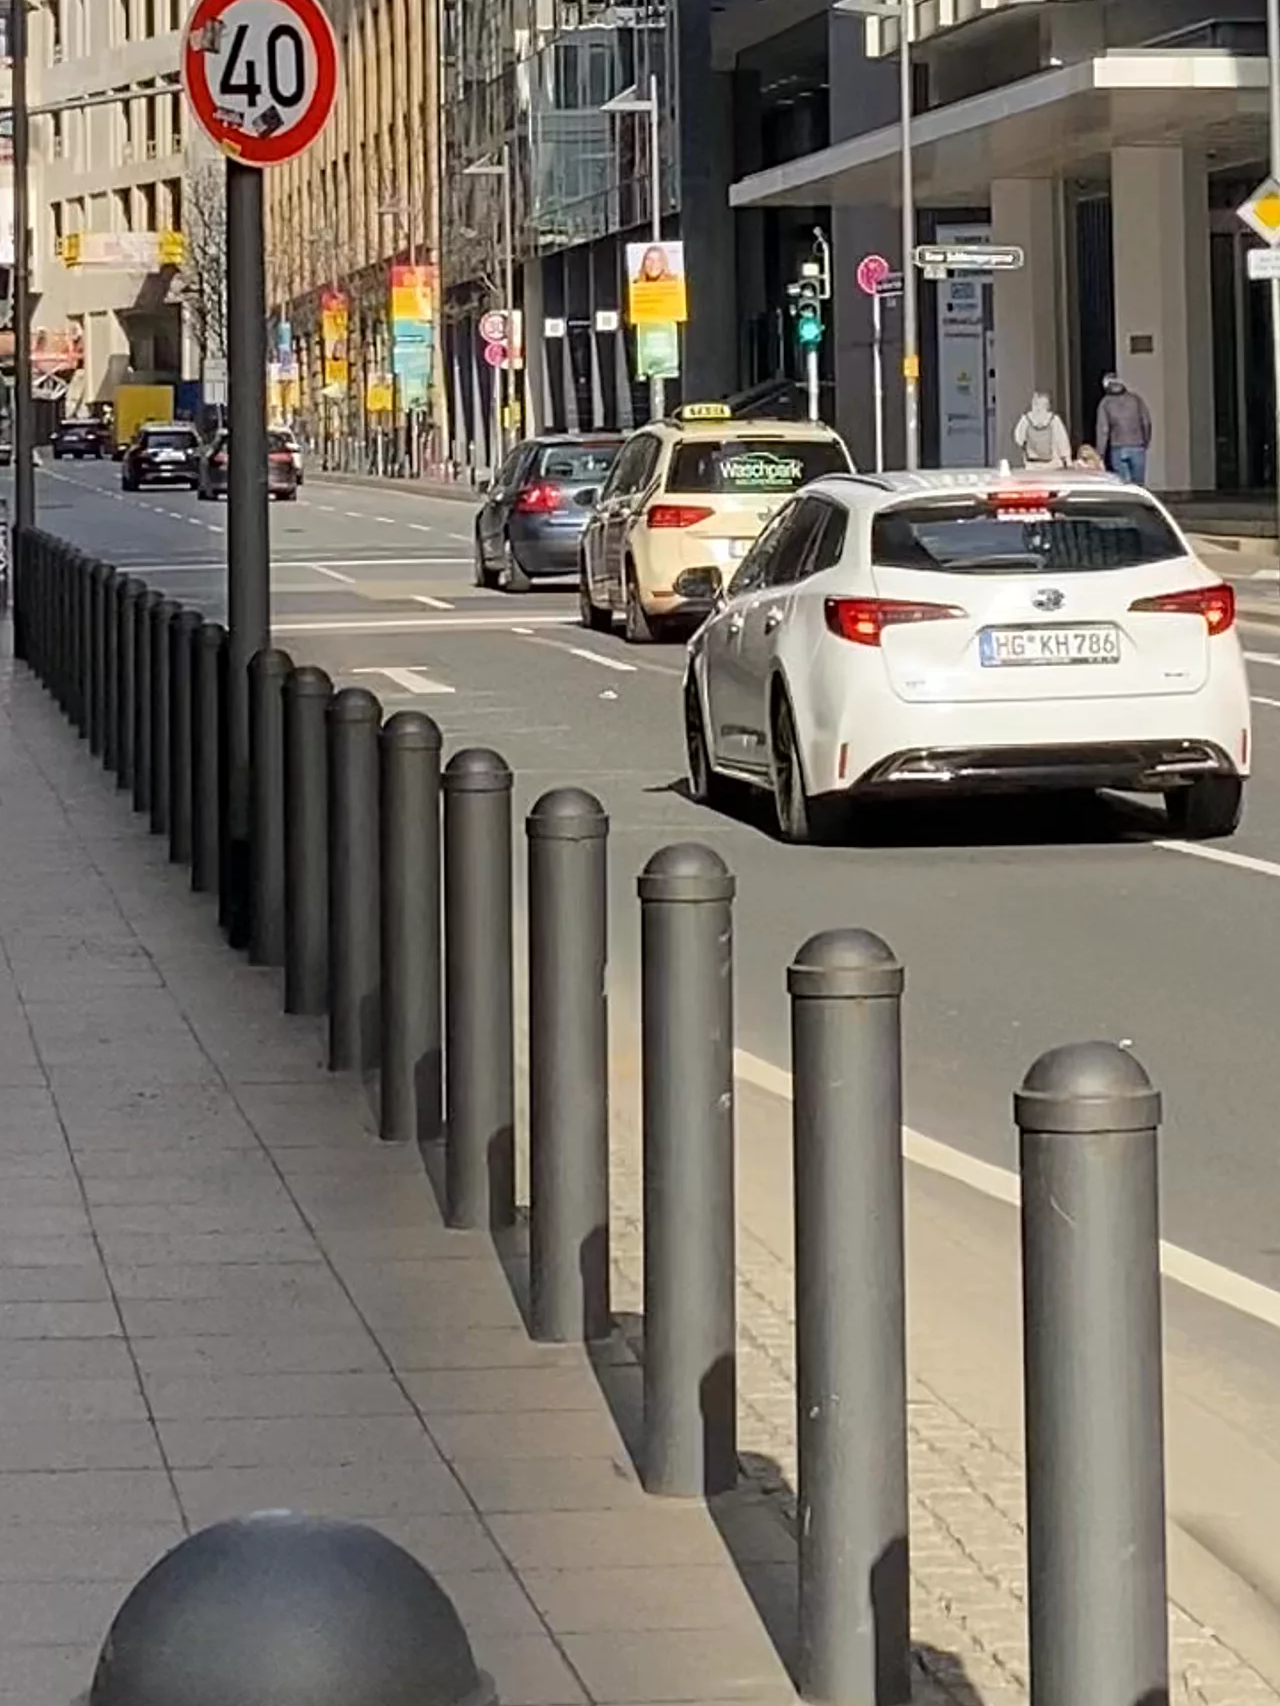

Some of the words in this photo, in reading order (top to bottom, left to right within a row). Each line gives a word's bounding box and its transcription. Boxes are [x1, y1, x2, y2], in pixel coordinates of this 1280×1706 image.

[220, 24, 305, 108] 40
[996, 635, 1025, 656] HG
[1040, 634, 1070, 655] KH
[1073, 633, 1116, 654] 786
